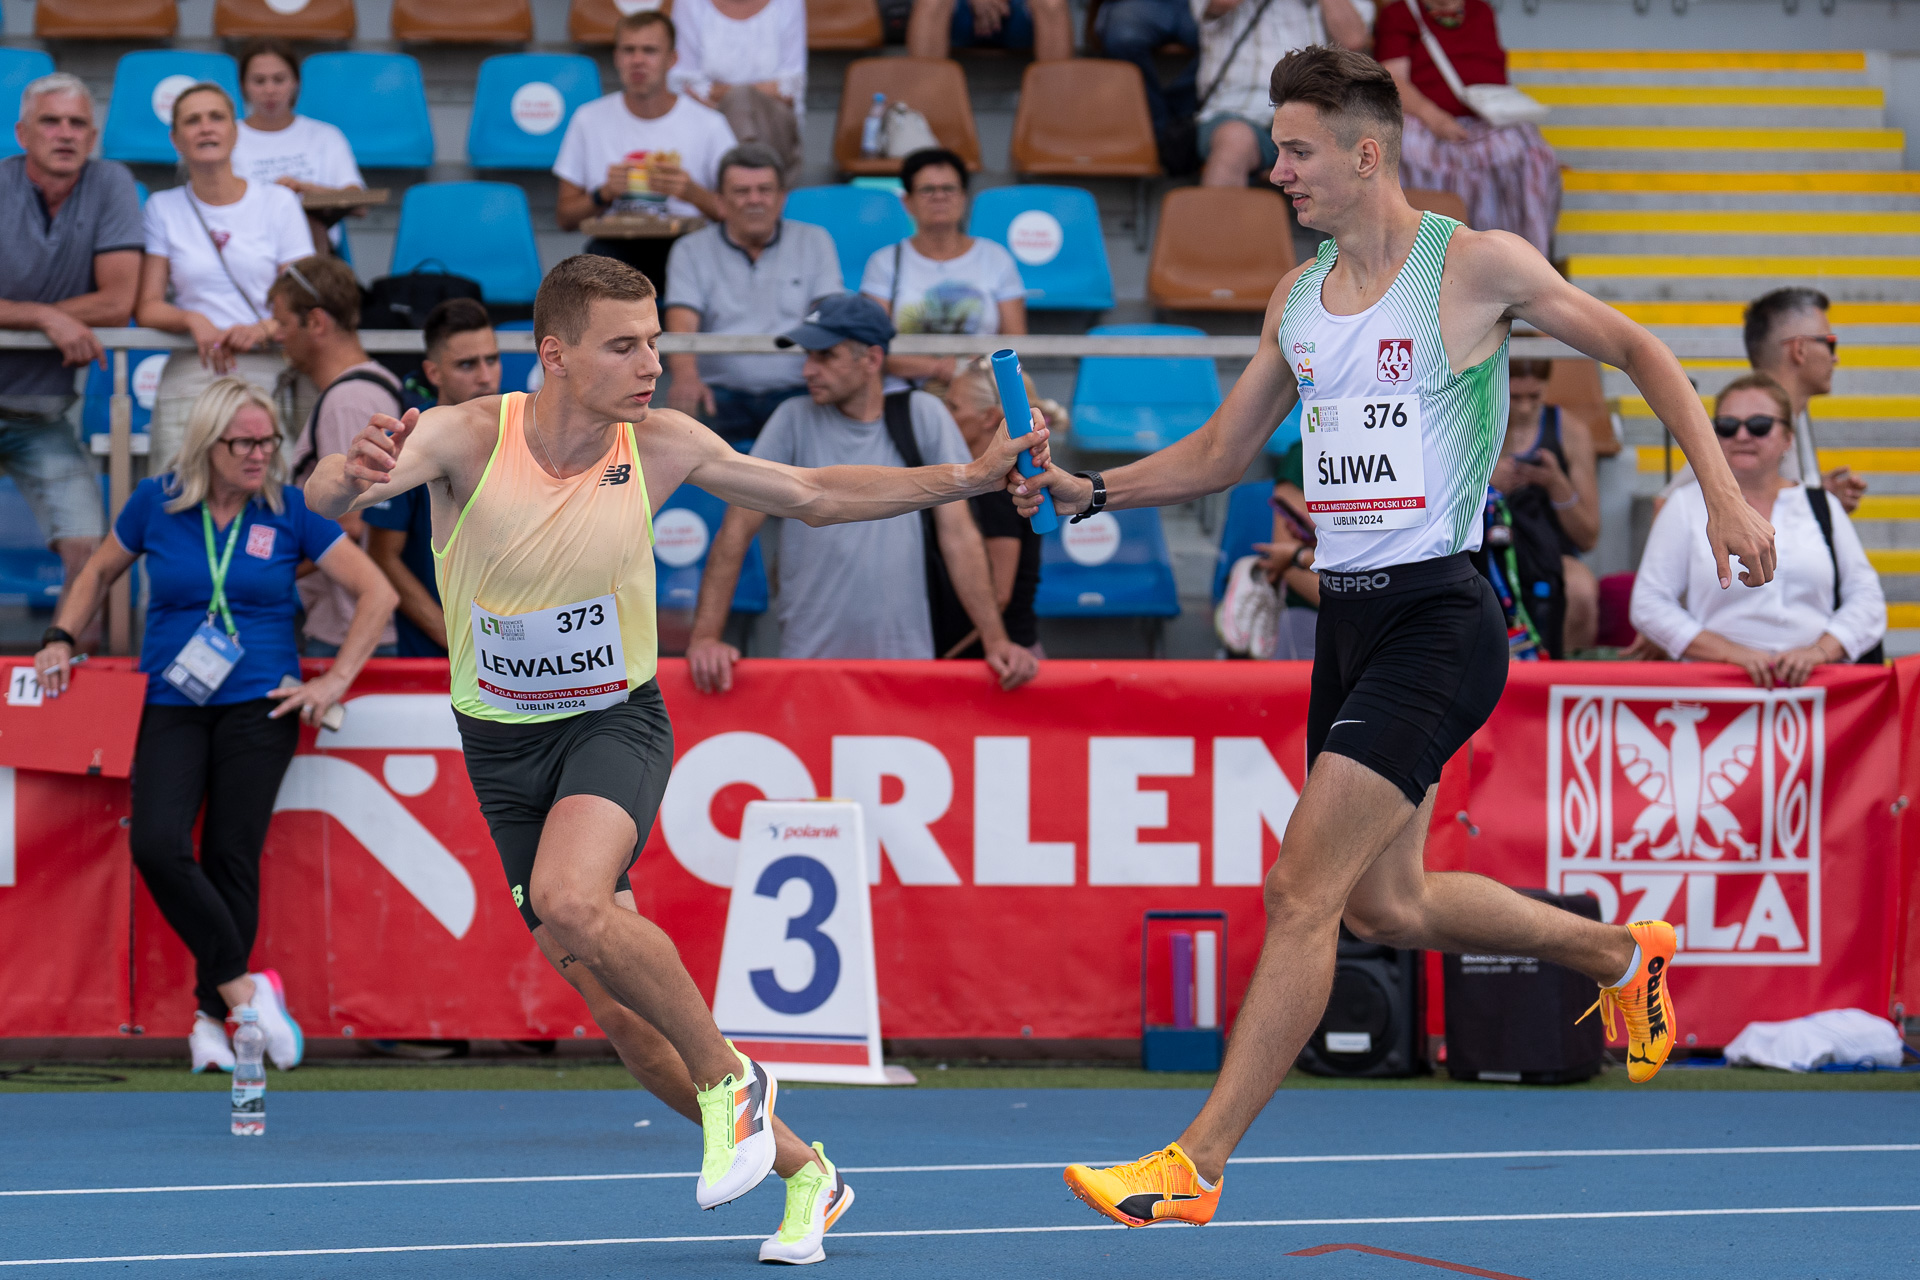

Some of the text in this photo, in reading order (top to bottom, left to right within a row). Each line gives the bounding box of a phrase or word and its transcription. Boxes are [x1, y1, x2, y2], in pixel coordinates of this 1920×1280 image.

[1363, 402, 1408, 429] 376
[1318, 451, 1397, 485] ŚLIWA
[1318, 503, 1331, 511] PZLA
[1331, 501, 1372, 511] MISTRZOSTWA
[1373, 500, 1400, 509] POLSKI
[1401, 499, 1417, 507] U23
[1333, 514, 1383, 526] LUBLIN 2024
[556, 604, 605, 634] 373
[481, 644, 614, 678] LEWALSKI
[484, 683, 620, 700] 41. PZLA MISTRZOSTWA POLSKI U23
[516, 700, 586, 711] LUBLIN 2024
[660, 730, 1301, 888] ORLEN
[783, 825, 840, 841] polanik
[748, 854, 841, 1016] 3
[1647, 956, 1669, 1045] NITRO
